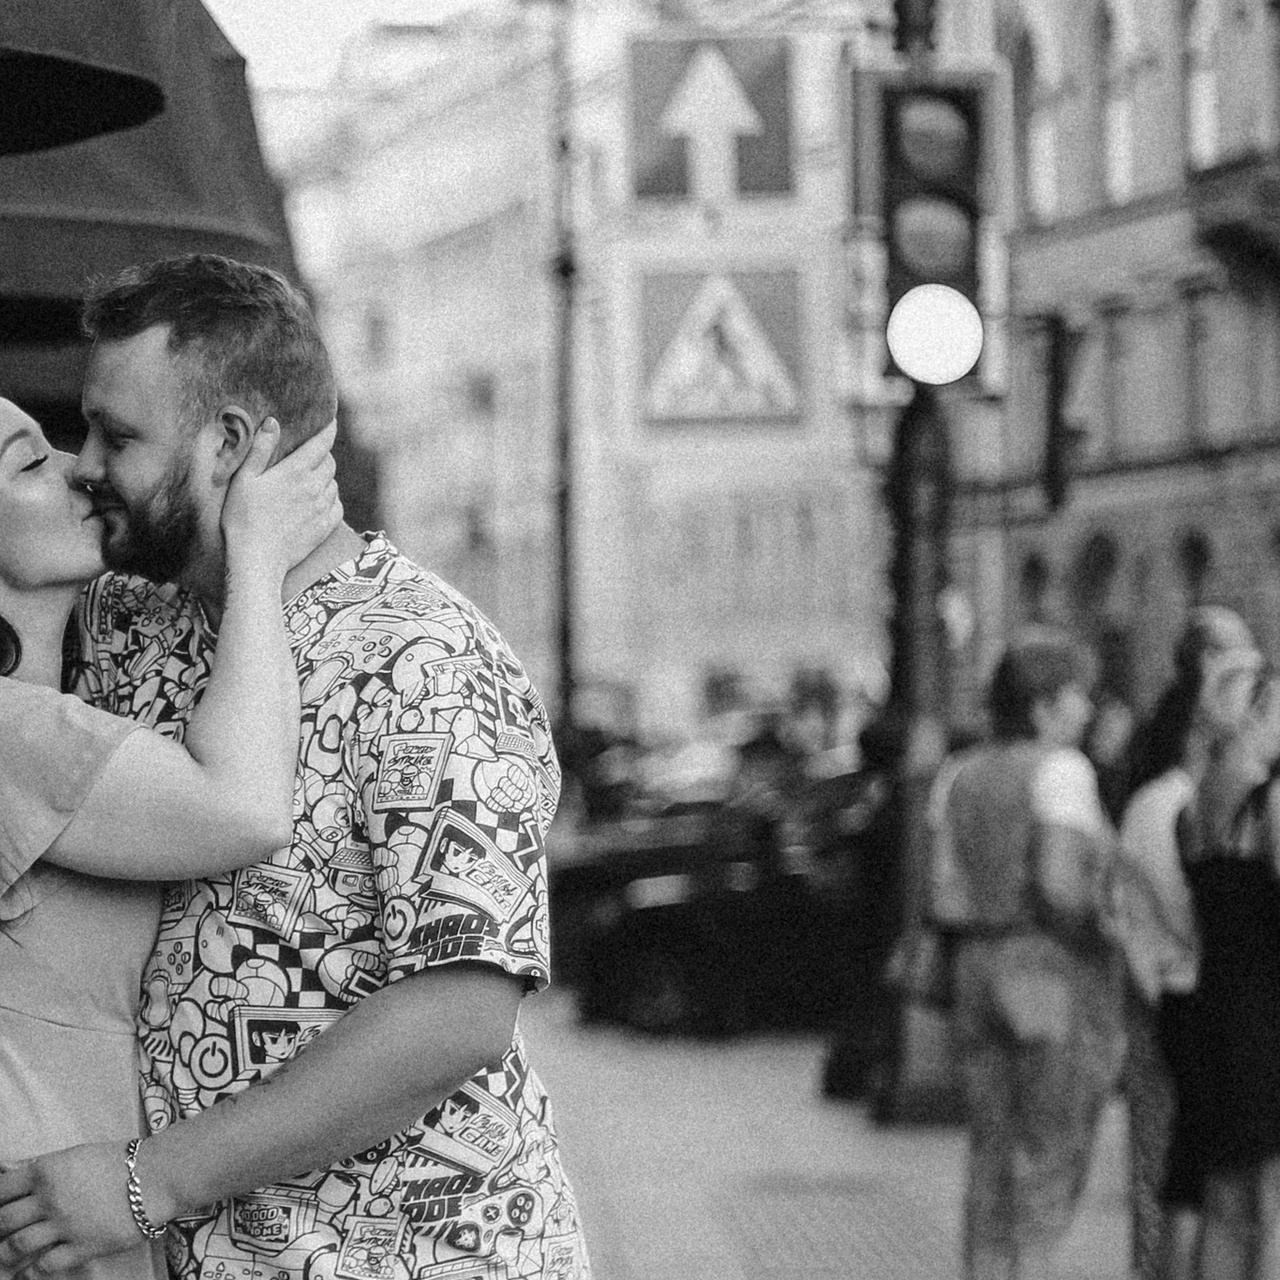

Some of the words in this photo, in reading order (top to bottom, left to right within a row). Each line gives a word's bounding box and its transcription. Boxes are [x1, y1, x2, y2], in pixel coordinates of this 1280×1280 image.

[466, 869, 512, 910] GAME
[459, 1127, 506, 1157] GAME
[252, 1223, 282, 1238] ONE
